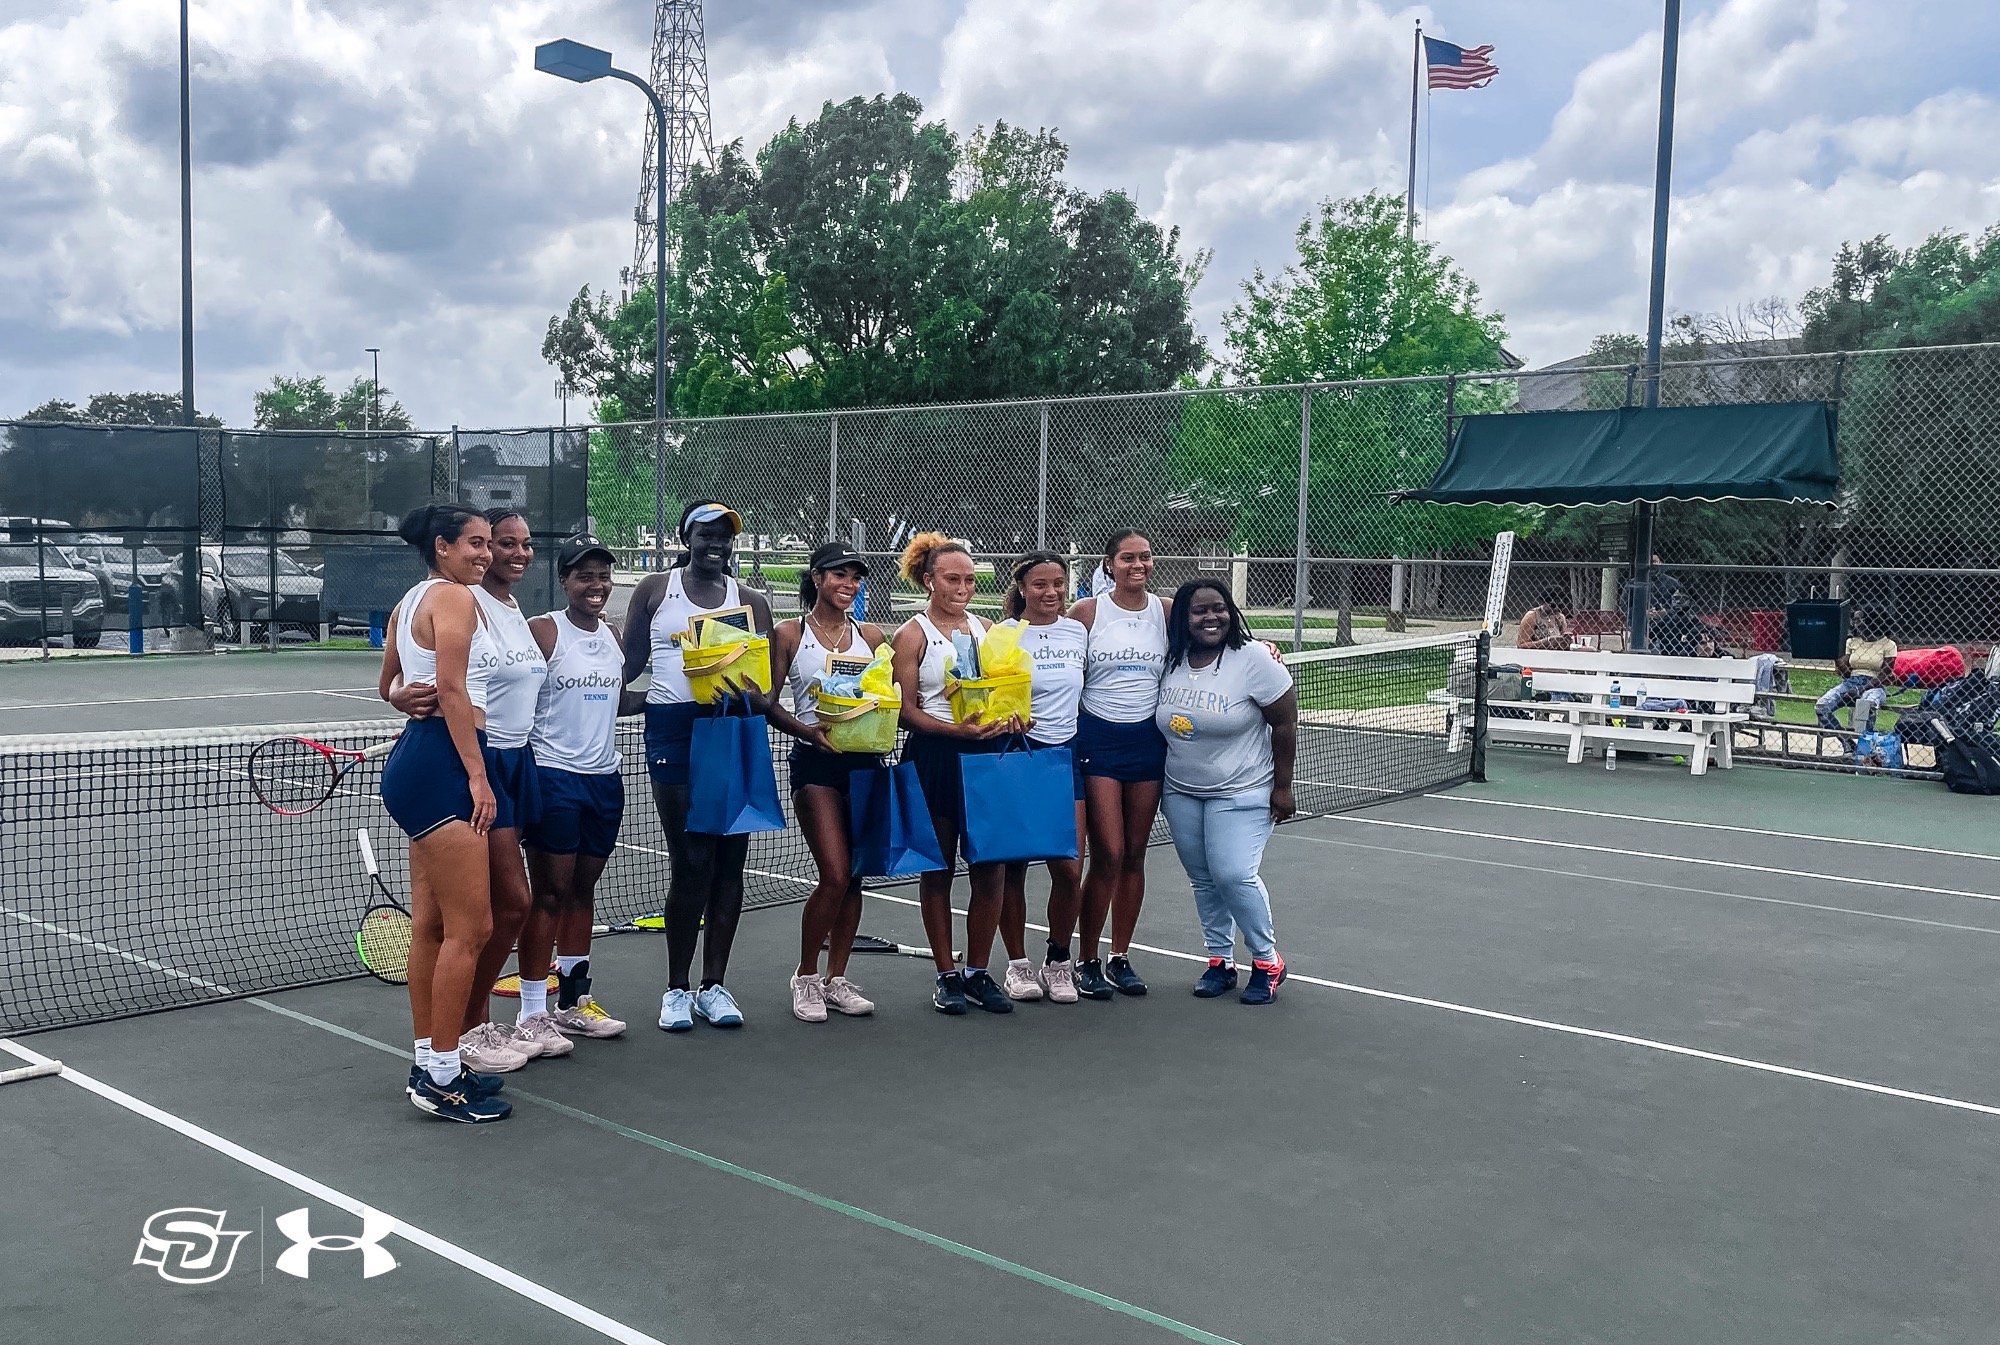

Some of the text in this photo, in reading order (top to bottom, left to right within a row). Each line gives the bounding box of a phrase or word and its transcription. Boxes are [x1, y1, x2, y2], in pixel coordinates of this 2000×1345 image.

[506, 646, 545, 666] South
[1033, 646, 1083, 660] uthern
[1159, 687, 1230, 715] OUTHERN
